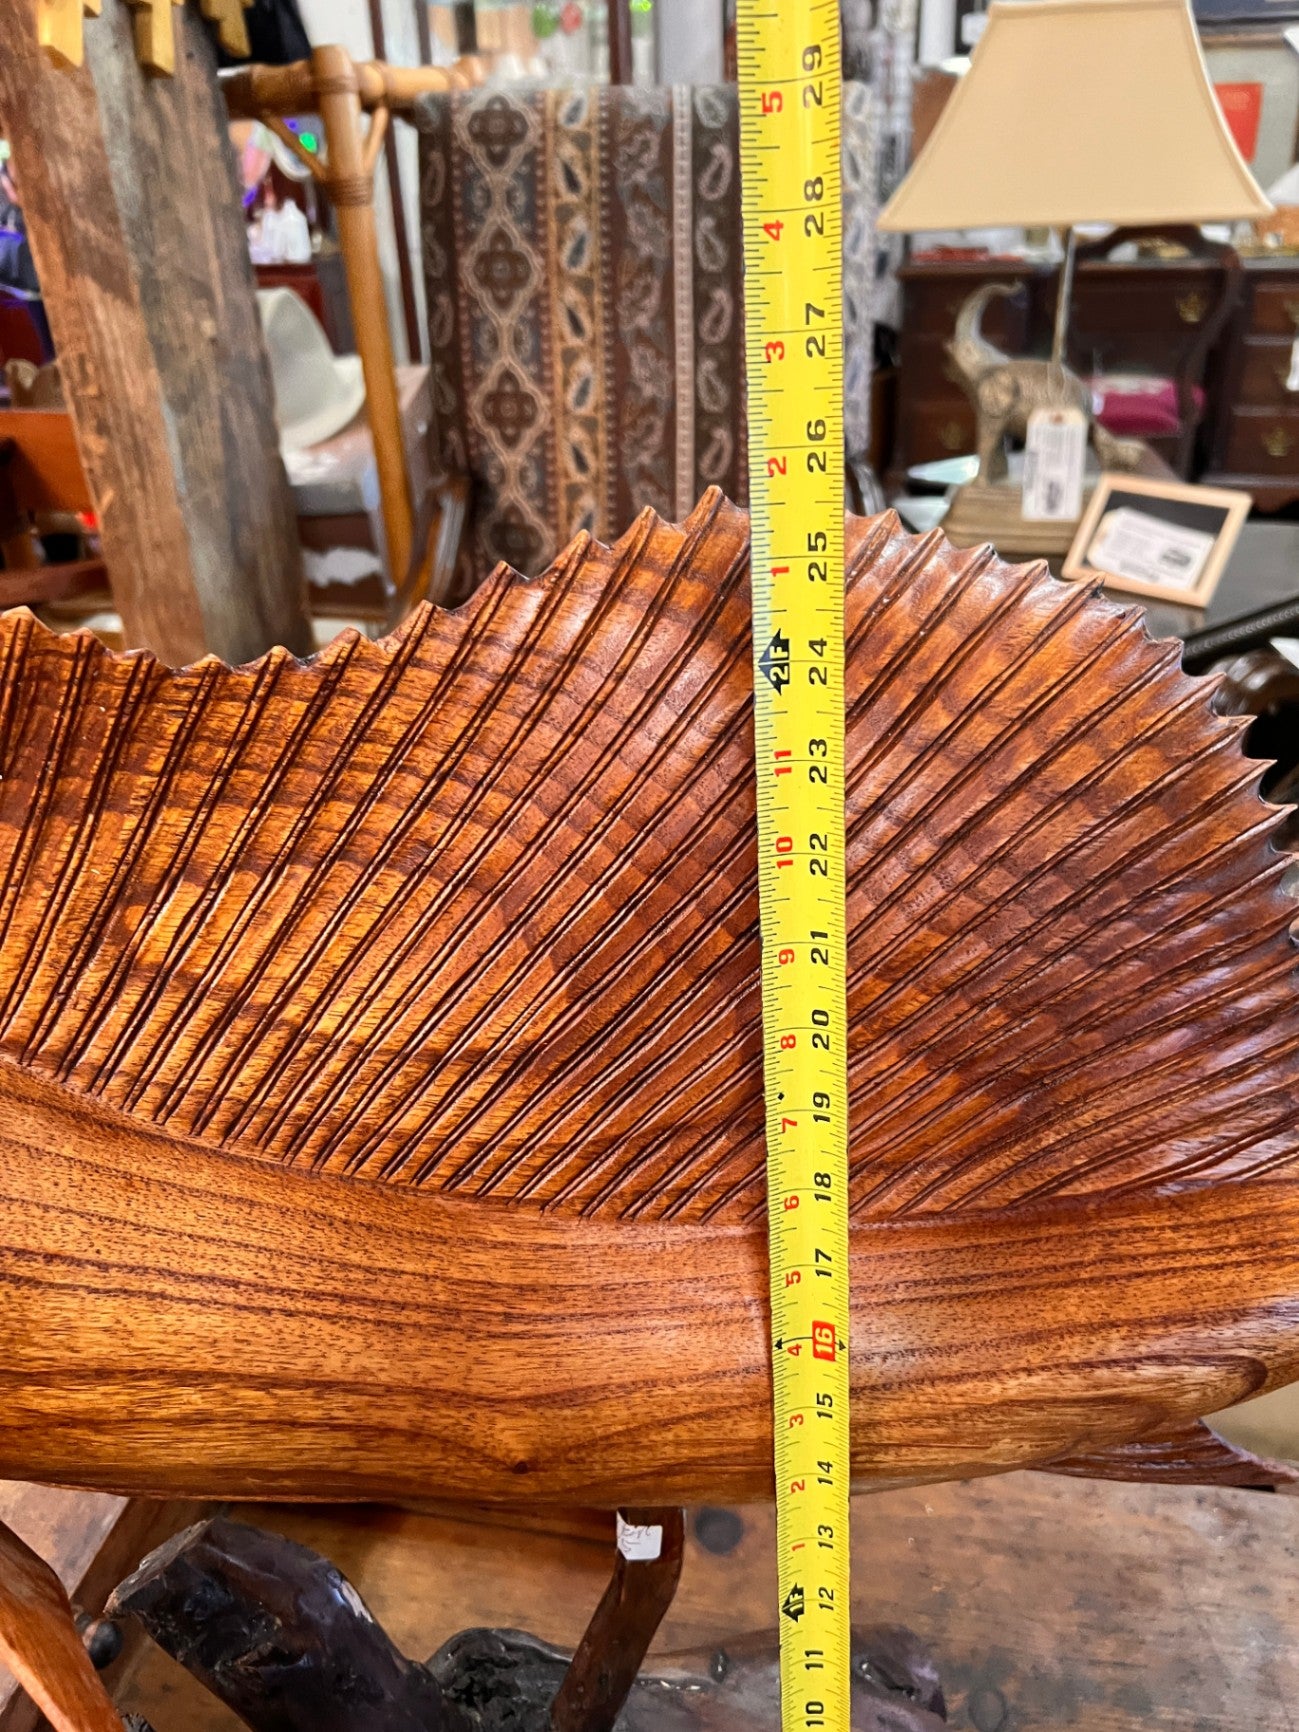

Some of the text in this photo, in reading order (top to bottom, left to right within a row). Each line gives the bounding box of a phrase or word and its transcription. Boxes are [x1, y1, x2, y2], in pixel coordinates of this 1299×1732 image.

[802, 44, 823, 109] 29
[761, 91, 783, 114] 5
[803, 176, 824, 237] 28
[763, 219, 784, 241] 4
[805, 302, 826, 358] 27
[765, 340, 785, 362] 3
[806, 418, 827, 473] 26
[768, 455, 787, 477] 2
[807, 531, 828, 582] 25
[771, 566, 790, 577] 1
[769, 644, 789, 683] 2F
[808, 637, 828, 686] 24
[773, 750, 793, 777] 11
[808, 738, 828, 784] 23
[775, 836, 794, 870] 10
[809, 833, 828, 877] 22
[778, 948, 796, 965] 9
[810, 929, 829, 966] 21
[780, 1033, 797, 1050] 8
[811, 1009, 830, 1051] 20
[812, 1091, 831, 1124] 19
[781, 1117, 798, 1133] 7
[814, 1172, 832, 1203] 18
[783, 1195, 800, 1211] 6
[815, 1248, 832, 1278] 17
[785, 1269, 801, 1288] 5
[787, 1343, 803, 1357] 4
[815, 1326, 834, 1356] 16
[816, 1392, 833, 1420] 15
[789, 1413, 804, 1429] 3
[790, 1478, 805, 1494] 2
[817, 1460, 834, 1486] 14
[791, 1542, 806, 1552] 1
[818, 1524, 834, 1550] 13
[789, 1592, 804, 1614] 1F
[818, 1586, 834, 1612] 12
[805, 1649, 824, 1671] 11
[805, 1701, 825, 1728] 10
